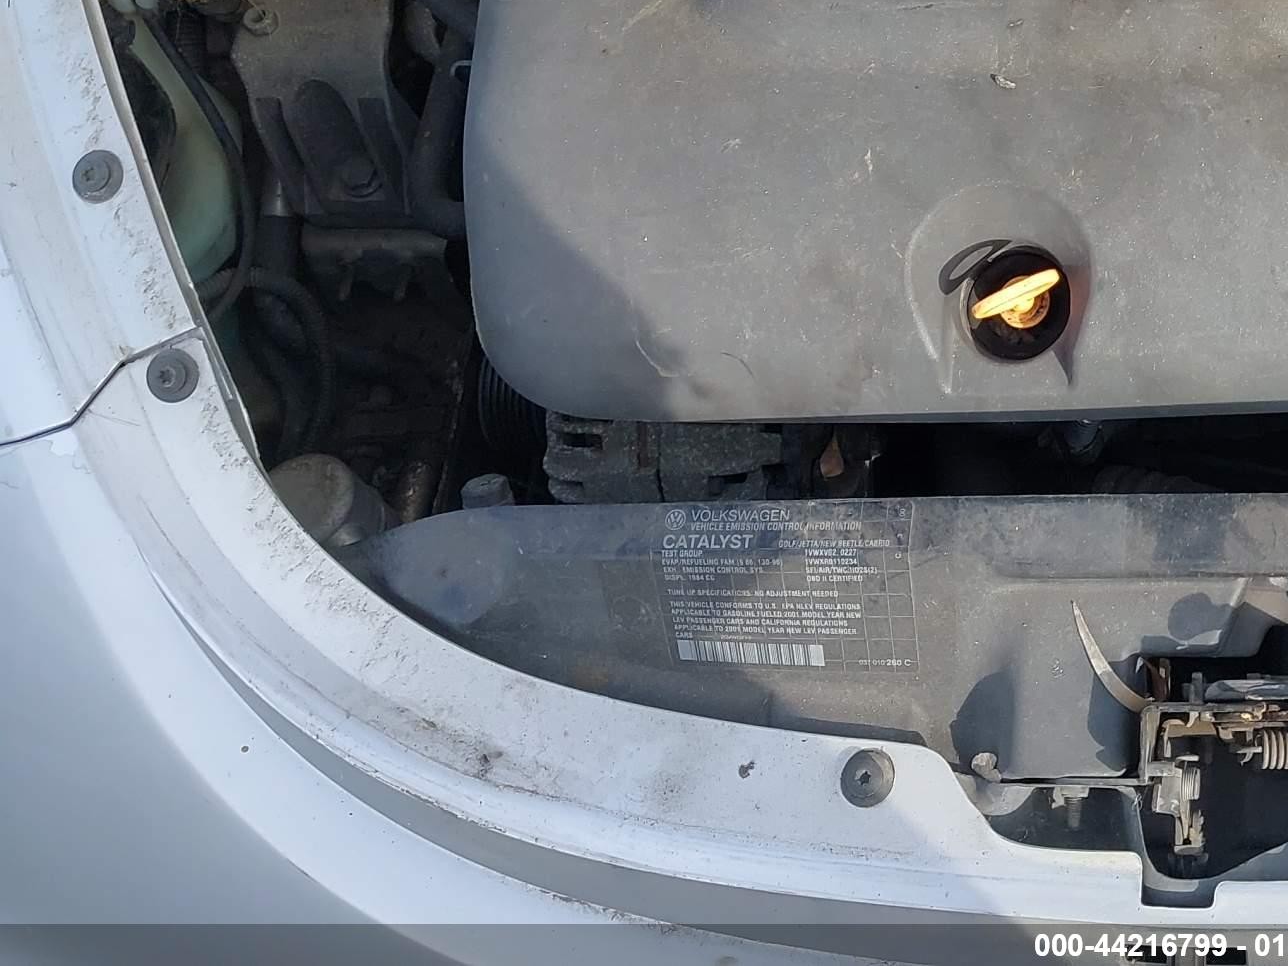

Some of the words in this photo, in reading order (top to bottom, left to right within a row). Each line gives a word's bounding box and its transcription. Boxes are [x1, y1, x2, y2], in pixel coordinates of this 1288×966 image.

[692, 509, 790, 521] VOLKSWAGEN
[690, 522, 725, 531] VEHICLE
[726, 522, 765, 531] EMISSION
[767, 522, 805, 531] CONTROL
[806, 522, 862, 531] INFORMATION
[662, 534, 754, 549] CATALYST
[661, 550, 678, 558] TEST
[679, 550, 703, 558] GROUP
[826, 611, 845, 619] YEAR
[847, 611, 862, 619] NEW
